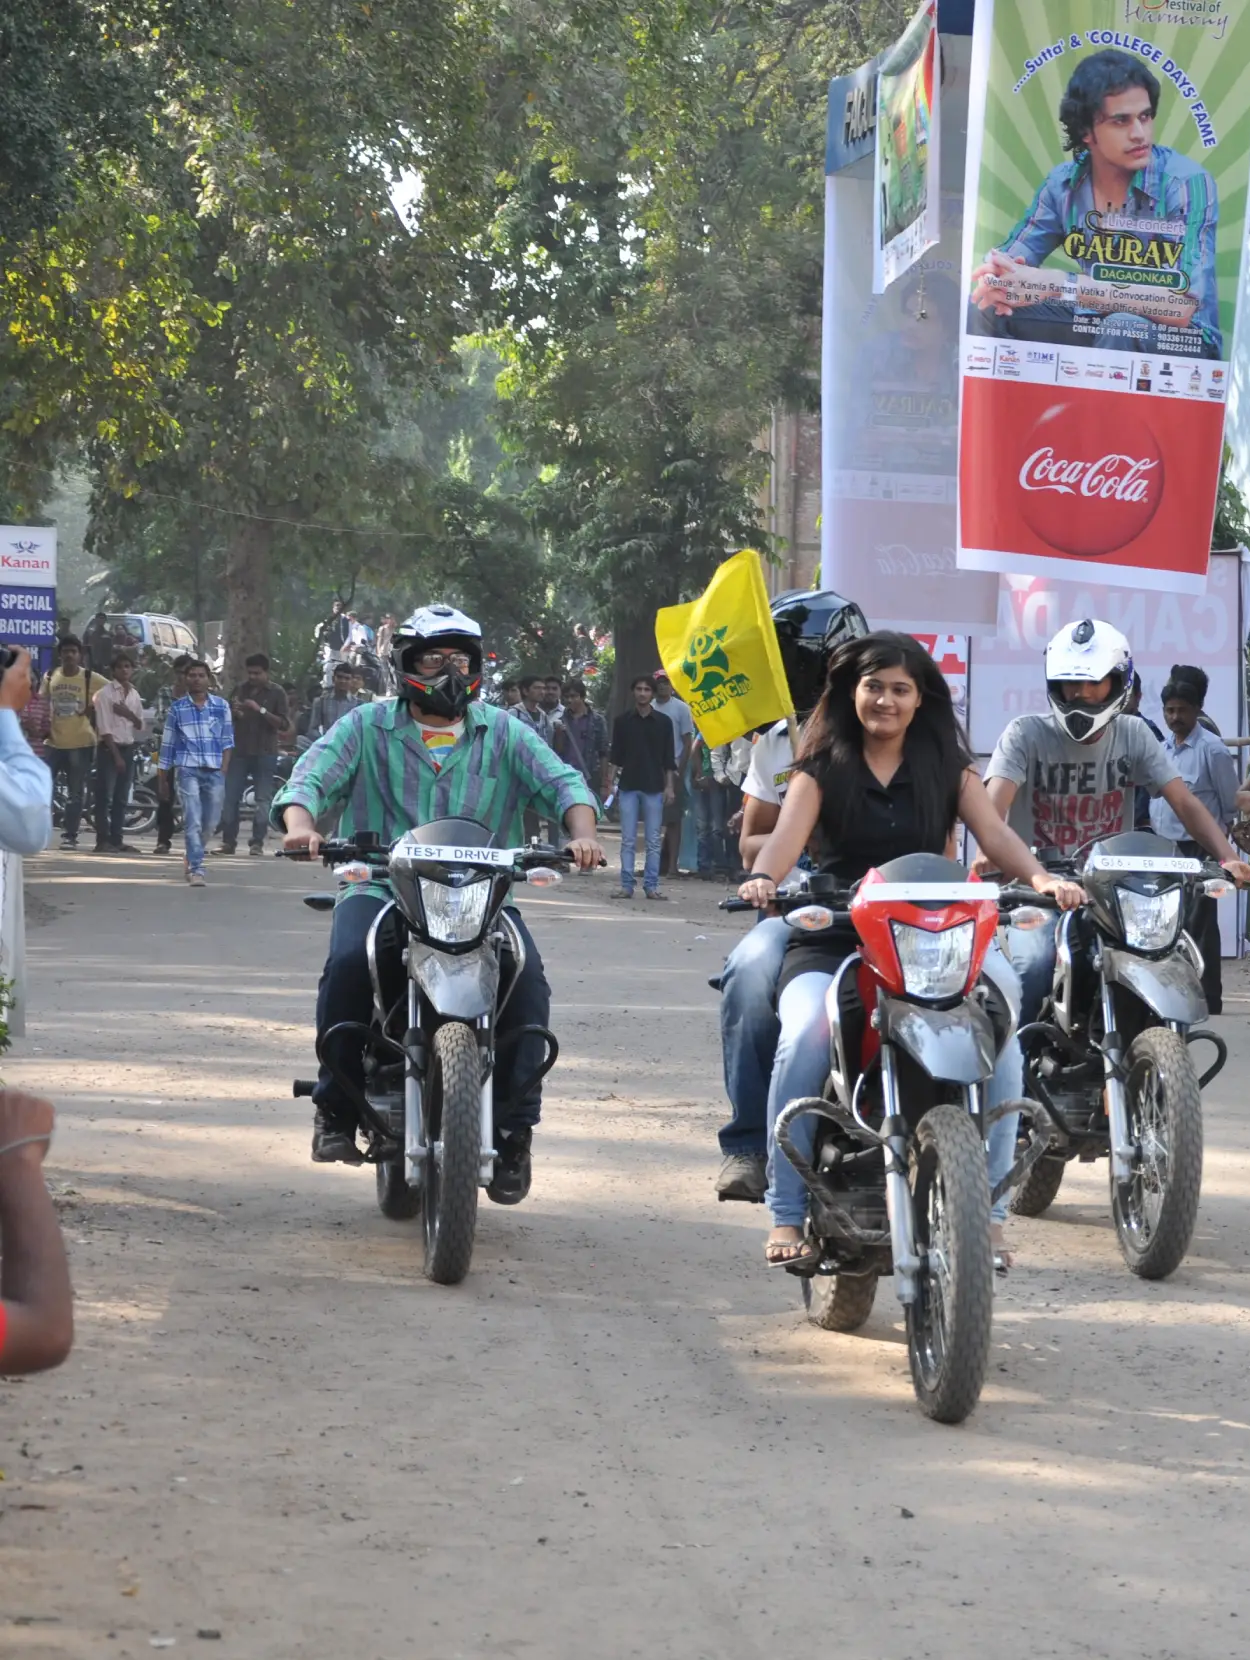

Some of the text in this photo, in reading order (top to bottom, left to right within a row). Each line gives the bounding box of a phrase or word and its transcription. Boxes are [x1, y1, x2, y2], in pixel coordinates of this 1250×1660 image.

[1070, 35, 1082, 48] &
[1191, 102, 1216, 147] FAME
[1063, 231, 1185, 269] GAURAV
[1100, 268, 1174, 286] DAGAONKAR
[1049, 283, 1078, 295] Raman
[1072, 324, 1105, 335] CONTACT
[1106, 328, 1121, 337] FOR
[1122, 329, 1149, 341] PASSES
[1019, 446, 1160, 503] Coca-Cola
[1, 555, 50, 569] Kanan
[1, 593, 53, 611] SPECIAL
[0, 618, 54, 636] BATCHES
[1034, 759, 1097, 795] LIFE
[404, 846, 500, 862] TEST DRIVE
